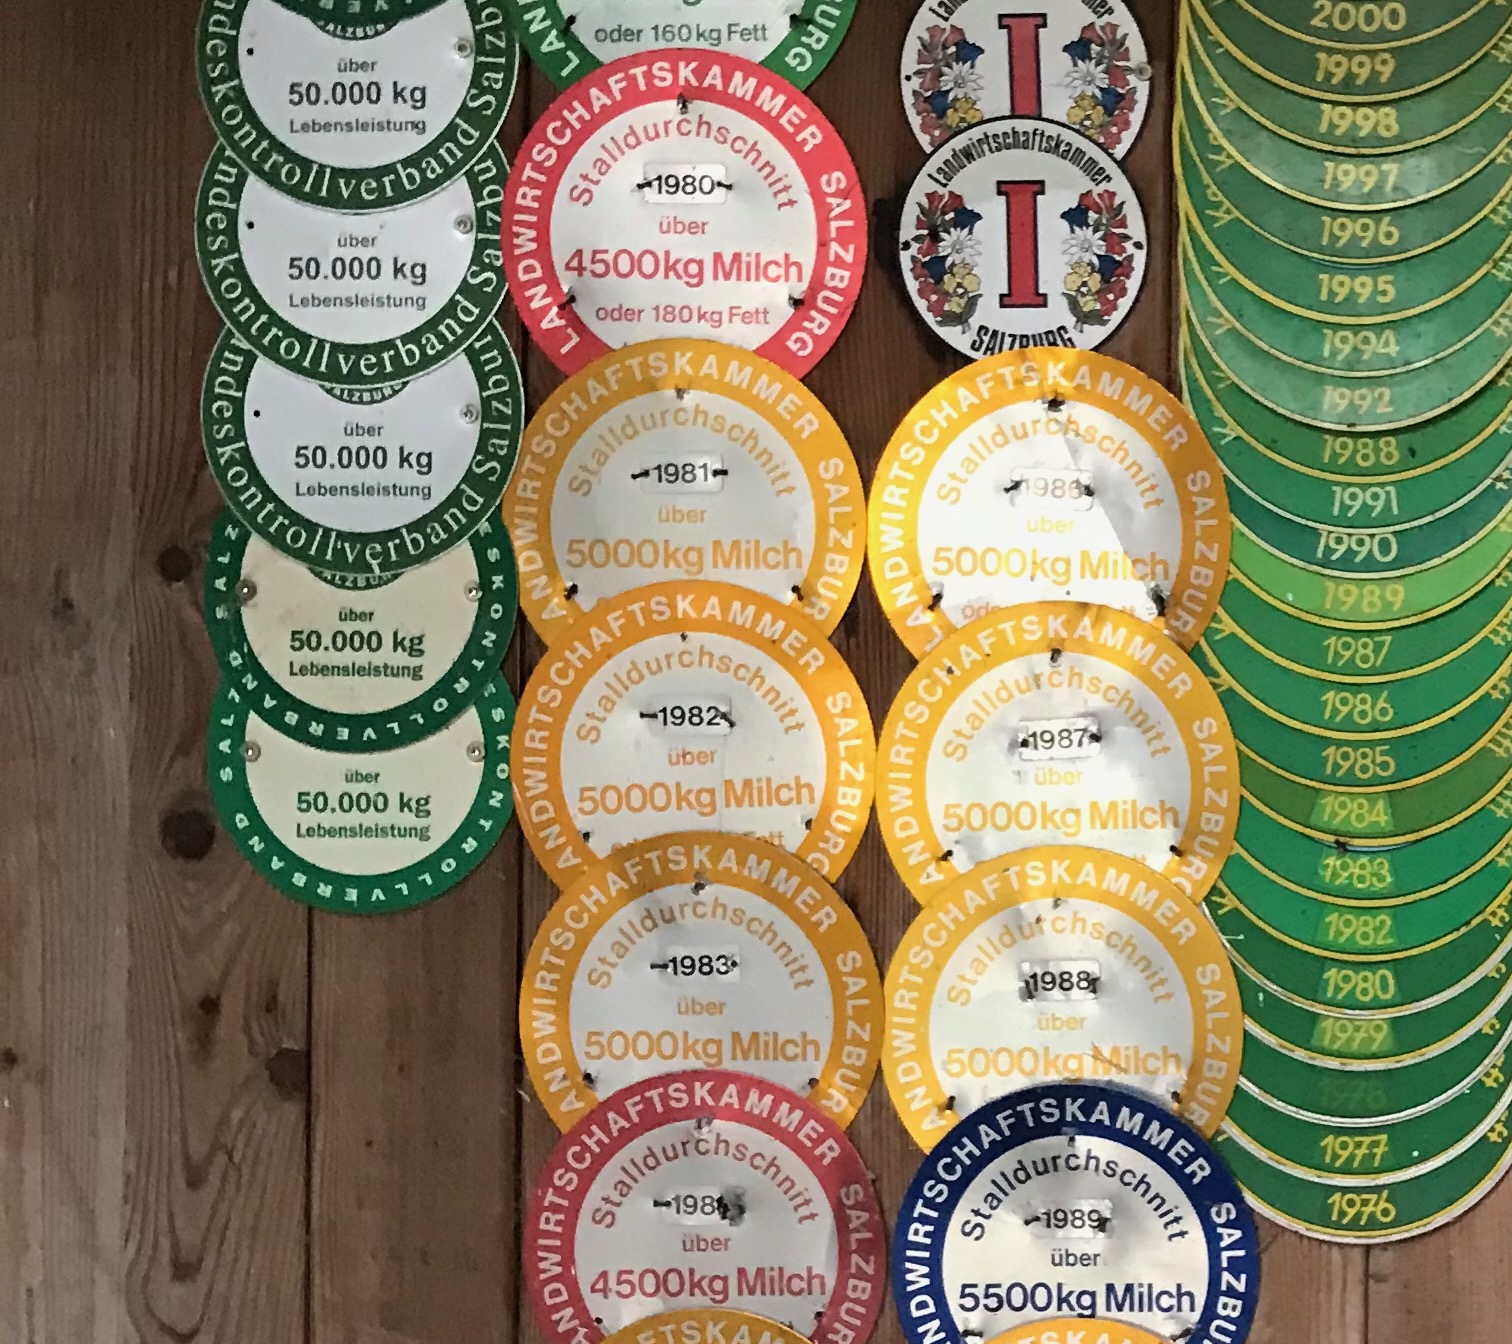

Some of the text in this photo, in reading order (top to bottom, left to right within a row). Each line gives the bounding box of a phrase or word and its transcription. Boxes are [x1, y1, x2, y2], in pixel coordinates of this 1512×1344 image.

[1311, 0, 1406, 32] 2000
[337, 58, 377, 73] über
[1316, 53, 1394, 84] 1999
[289, 81, 426, 110] 50.000 kg
[290, 119, 426, 135] Lebensleistung
[1319, 104, 1399, 137] 1998
[569, 112, 799, 213] Stalldurchschnitt
[927, 128, 1112, 189] Landwirtschaftskammer
[655, 175, 715, 195] 1980
[1318, 160, 1399, 192] 1997
[512, 61, 854, 357] LANDWIRTSCHAFTSKAMMER SALZBURG
[659, 216, 708, 235] über
[1322, 217, 1399, 247] 1996
[713, 252, 802, 282] Milch
[1319, 274, 1395, 303] 1995
[1324, 330, 1400, 360] 1994
[1323, 386, 1393, 413] 1992
[1324, 436, 1399, 466] 1988
[653, 463, 711, 484] 1981
[1332, 486, 1398, 517] 1991
[712, 540, 801, 569] Milch
[1317, 531, 1397, 562] 1990
[1324, 585, 1403, 611] 1989
[1323, 636, 1392, 668] 1987
[657, 706, 720, 726] 1982
[1321, 691, 1393, 724] 1986
[1028, 729, 1087, 751] 1987
[345, 770, 380, 783] über
[1322, 746, 1395, 778] 1985
[297, 792, 431, 818] 50.000 kg
[1322, 797, 1388, 827] 1984
[297, 823, 430, 841] Lebensleistung
[1326, 913, 1393, 945] 1982
[668, 955, 729, 977] 1983
[1324, 968, 1394, 1001] 1980
[732, 1032, 819, 1061] Milch
[1323, 1019, 1387, 1049] 1979
[1315, 1134, 1388, 1170] 1977
[1046, 1210, 1102, 1231] 1989
[1328, 1190, 1395, 1225] 1976
[1106, 1283, 1195, 1312] Milch
